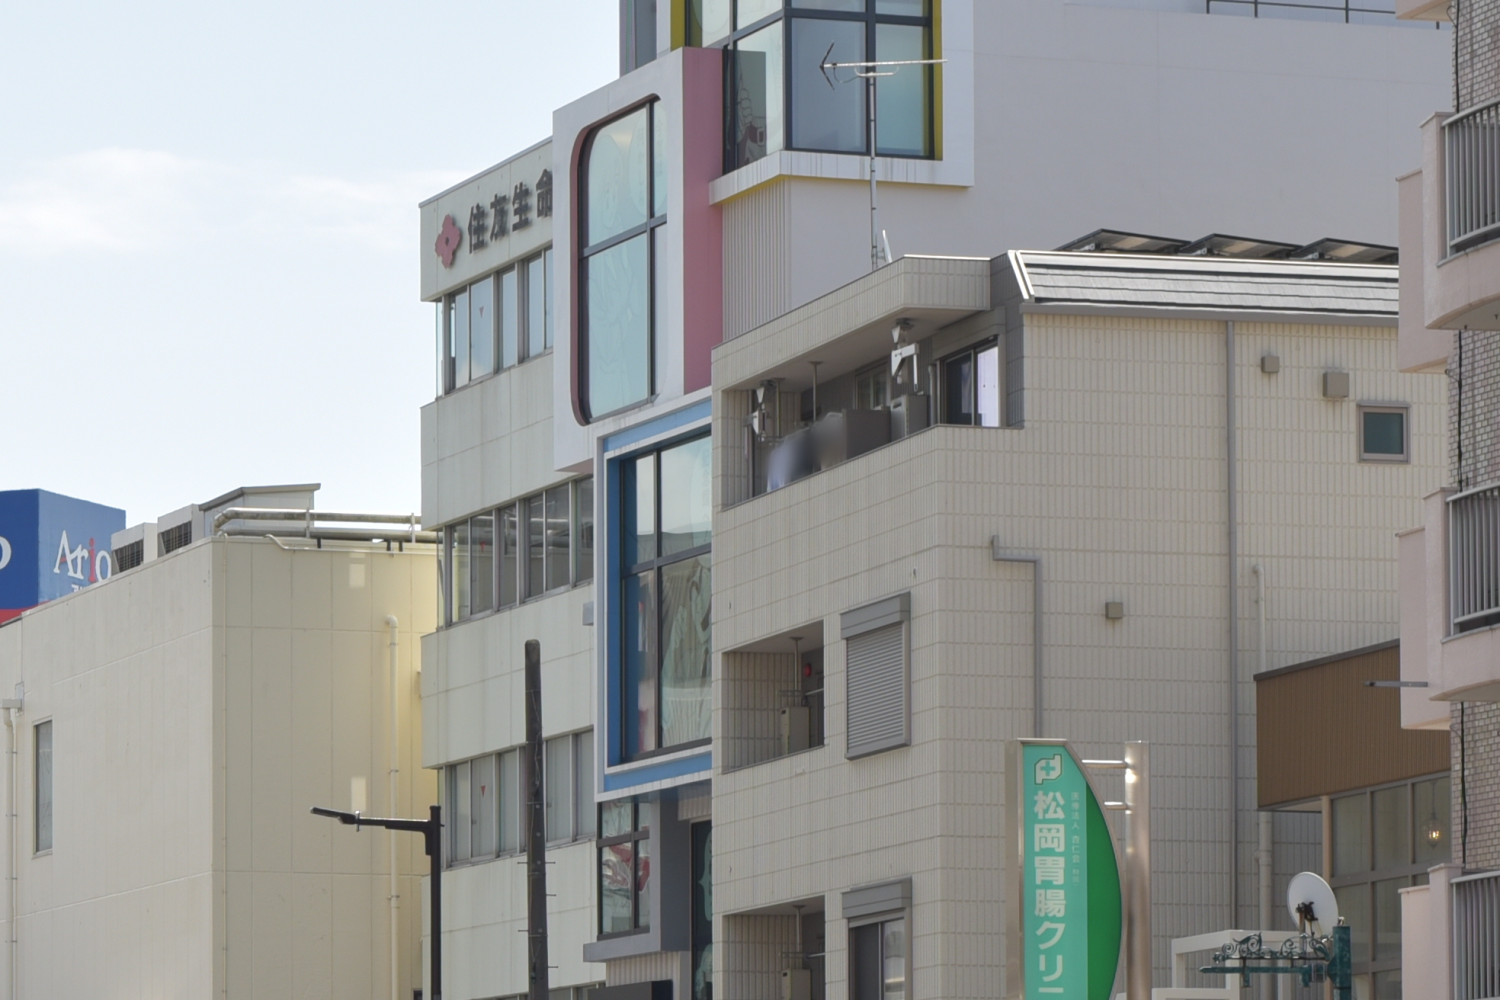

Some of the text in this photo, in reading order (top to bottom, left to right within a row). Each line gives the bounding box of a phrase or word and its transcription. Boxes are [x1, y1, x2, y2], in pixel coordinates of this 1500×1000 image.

[468, 168, 552, 254] 住友生命
[53, 529, 112, 583] Ario
